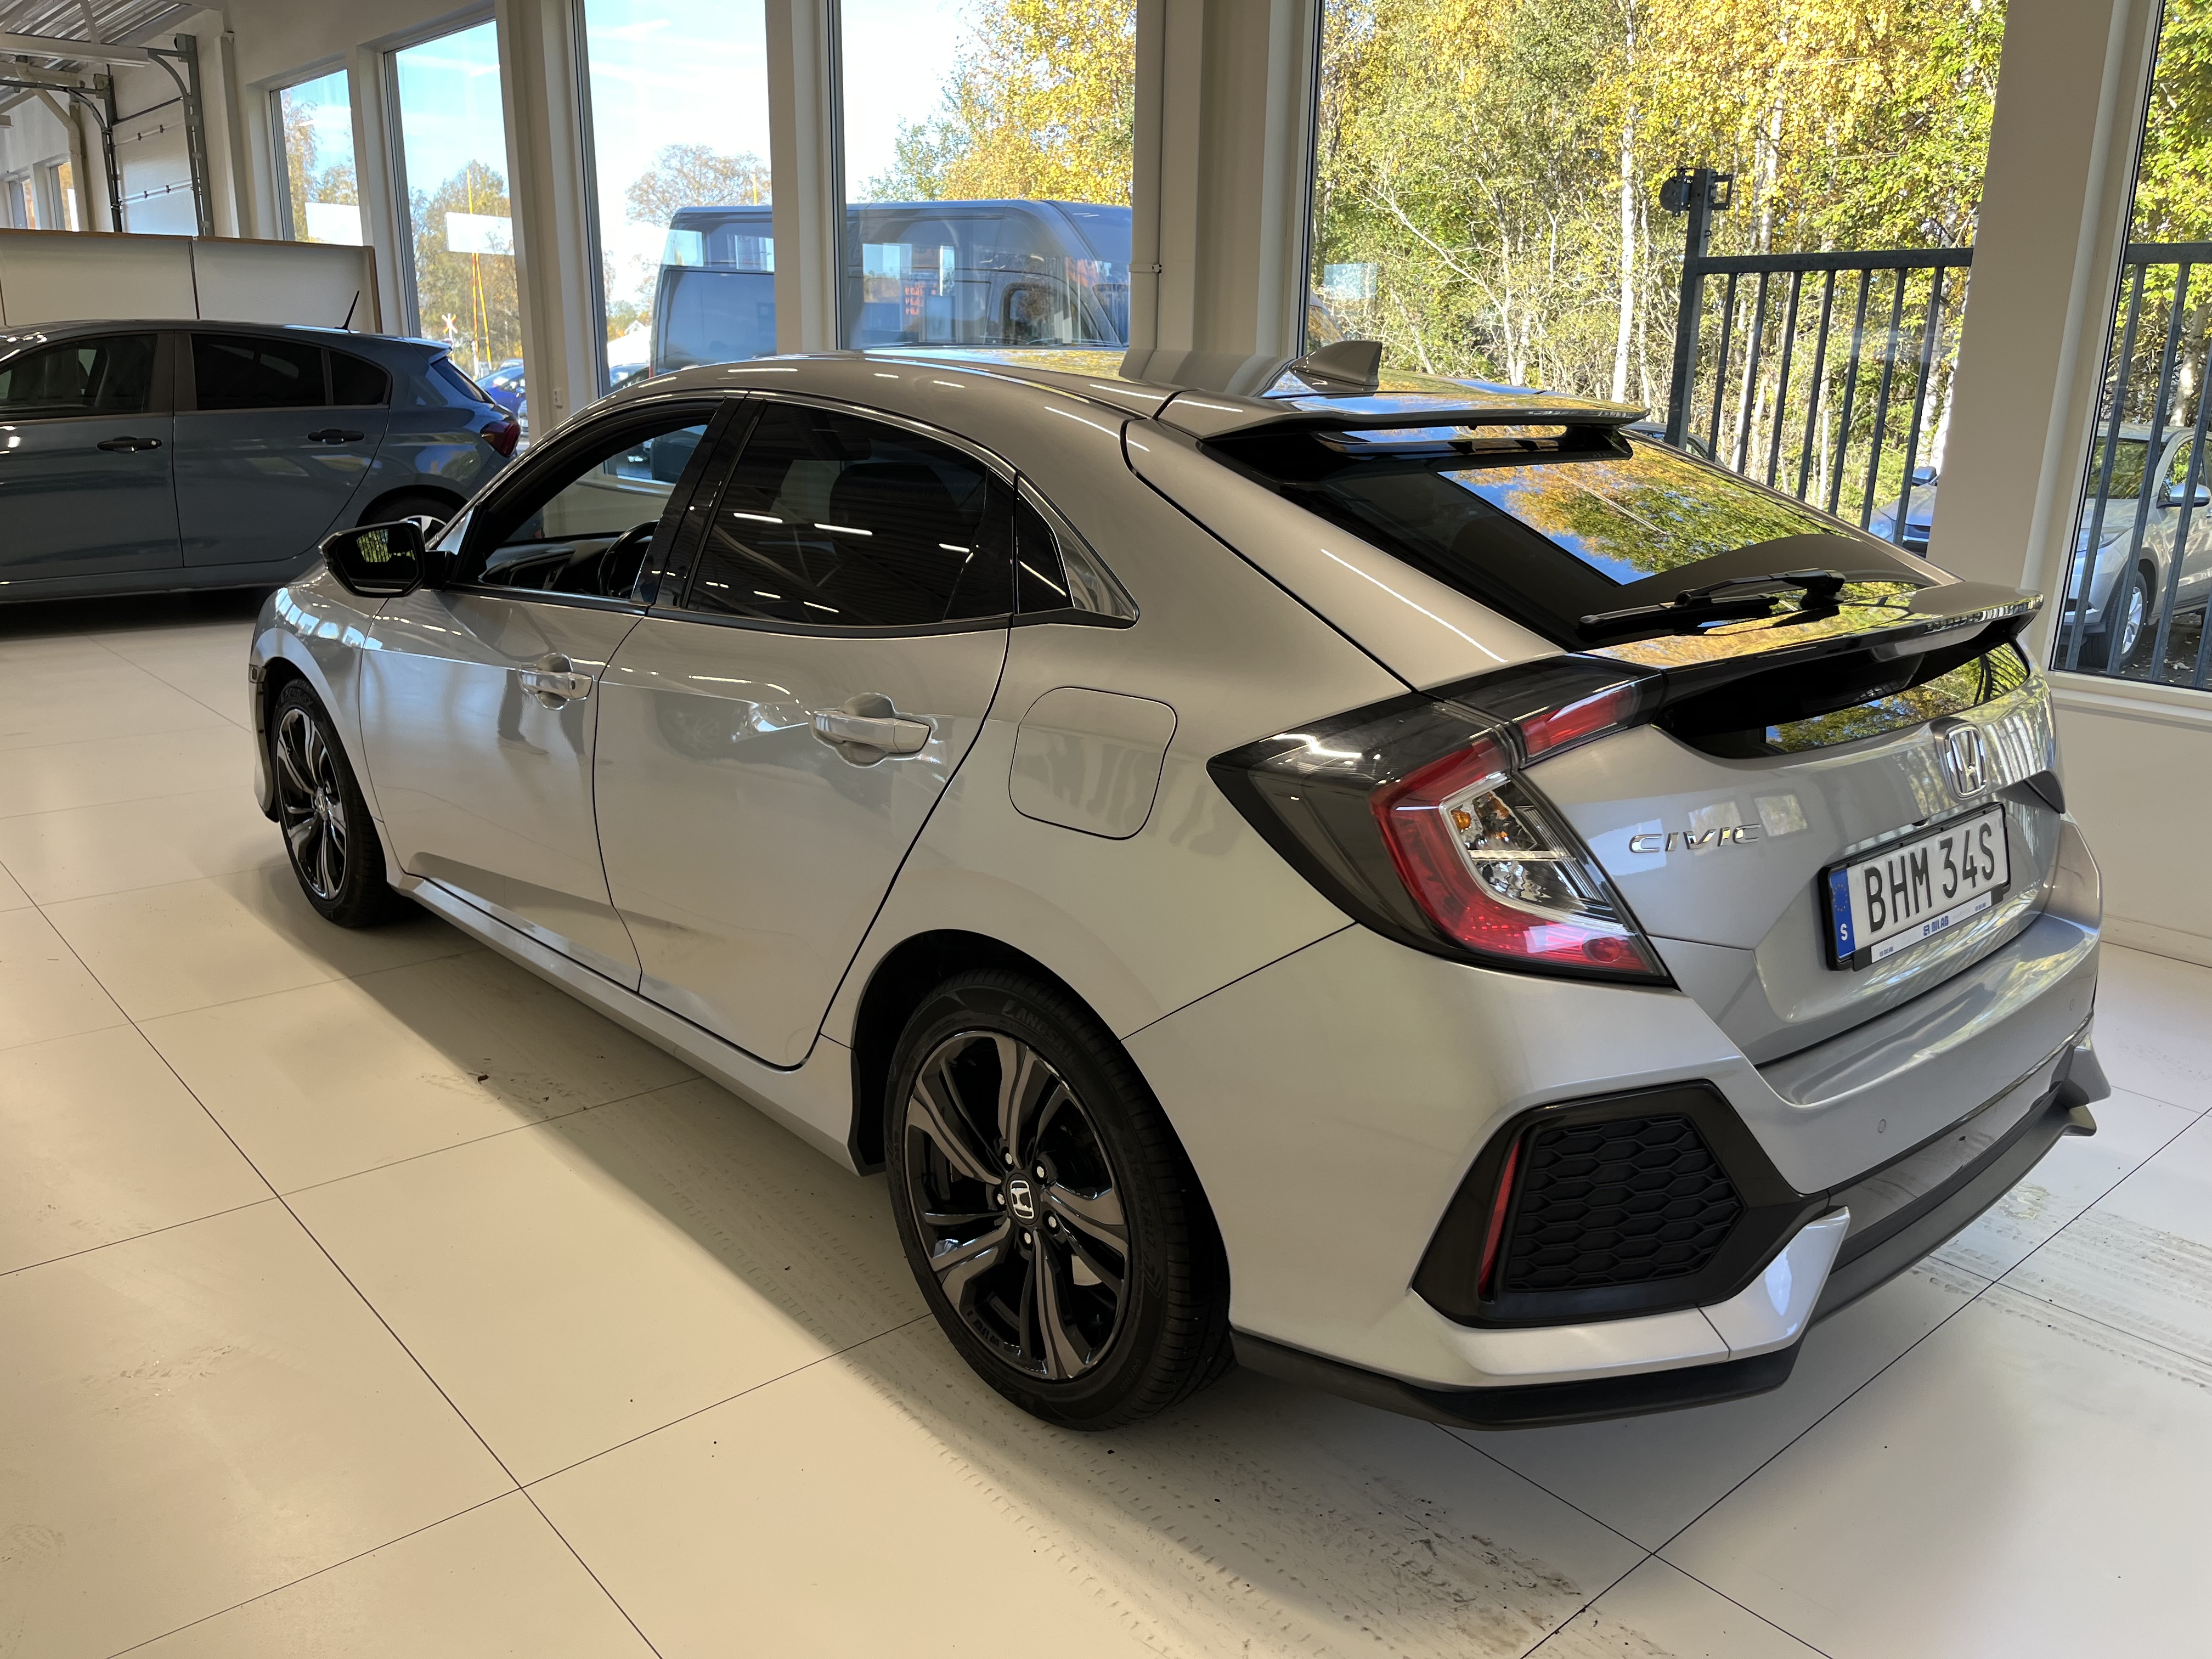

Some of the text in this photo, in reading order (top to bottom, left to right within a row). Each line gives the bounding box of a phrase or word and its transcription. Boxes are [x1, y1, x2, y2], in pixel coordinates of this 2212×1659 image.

[1629, 823, 1760, 853] CIVIC
[1864, 821, 1995, 933] BHM 34S
[1840, 923, 1848, 941] S
